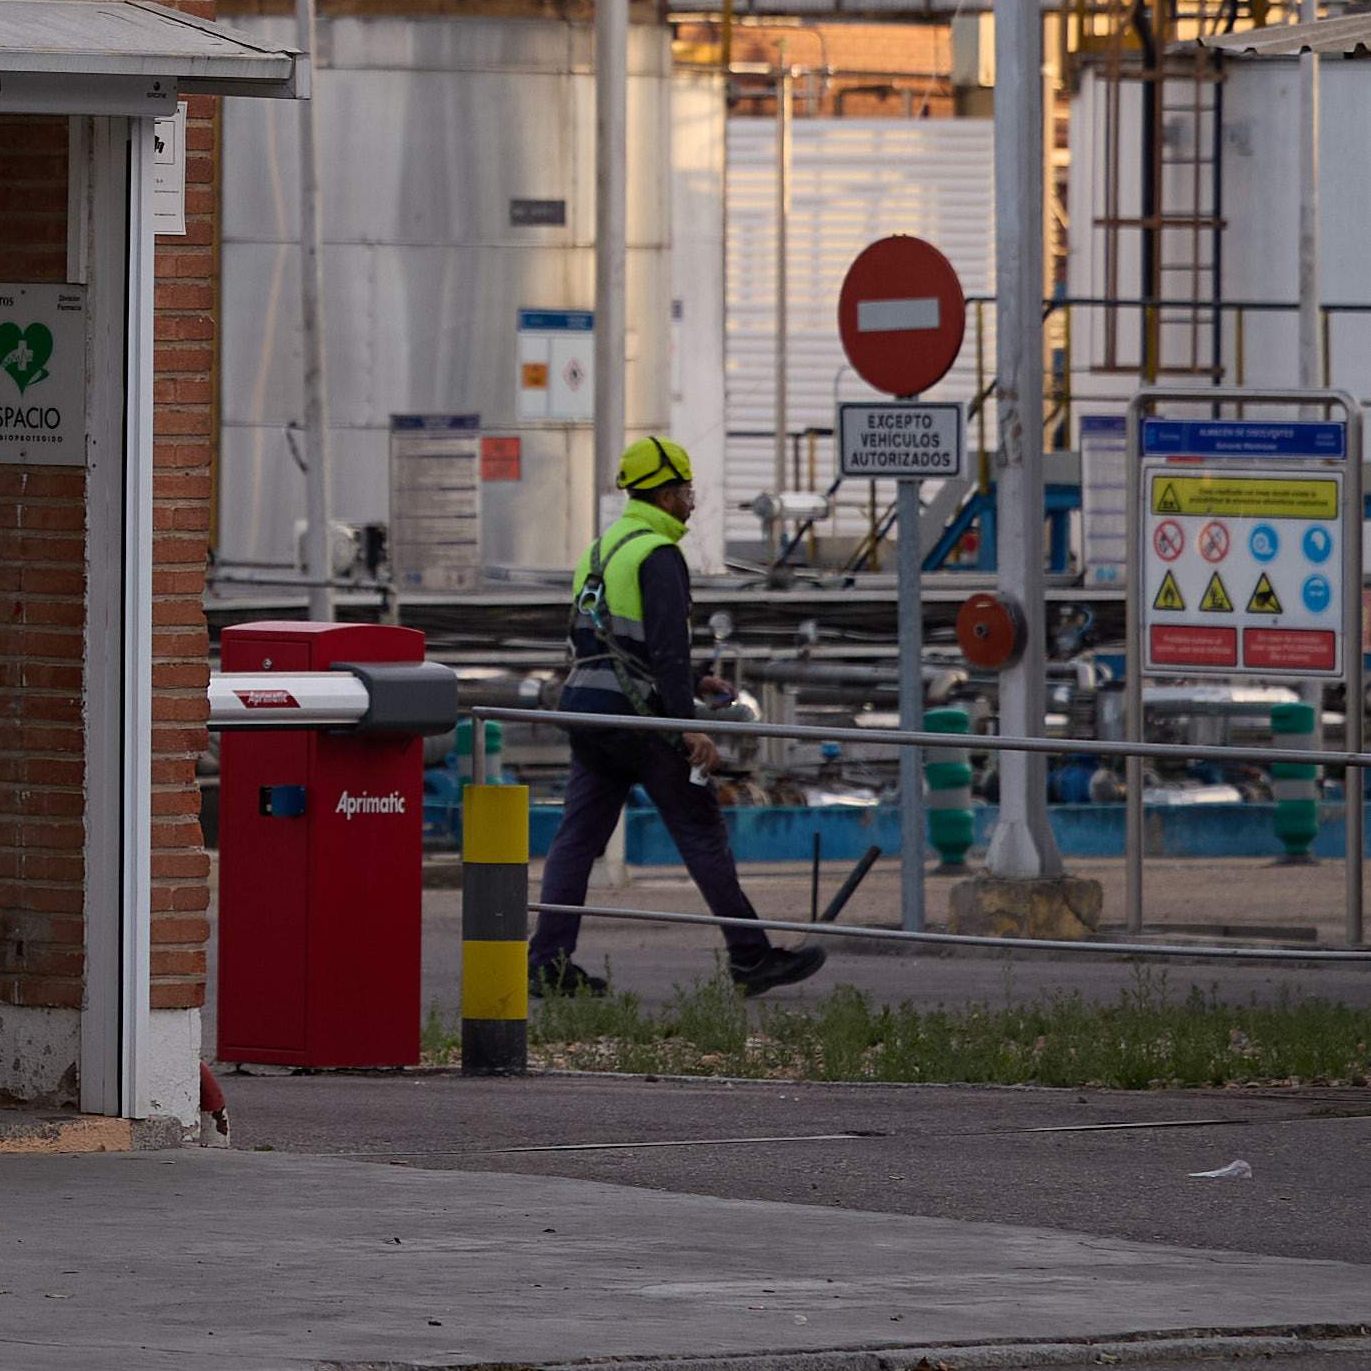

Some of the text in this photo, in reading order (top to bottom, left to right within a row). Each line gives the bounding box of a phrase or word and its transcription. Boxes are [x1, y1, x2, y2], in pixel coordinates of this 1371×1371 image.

[867, 414, 933, 429] EXCEPTO
[851, 452, 951, 467] AUTORIZADOS
[335, 790, 405, 820] Aprimatic
